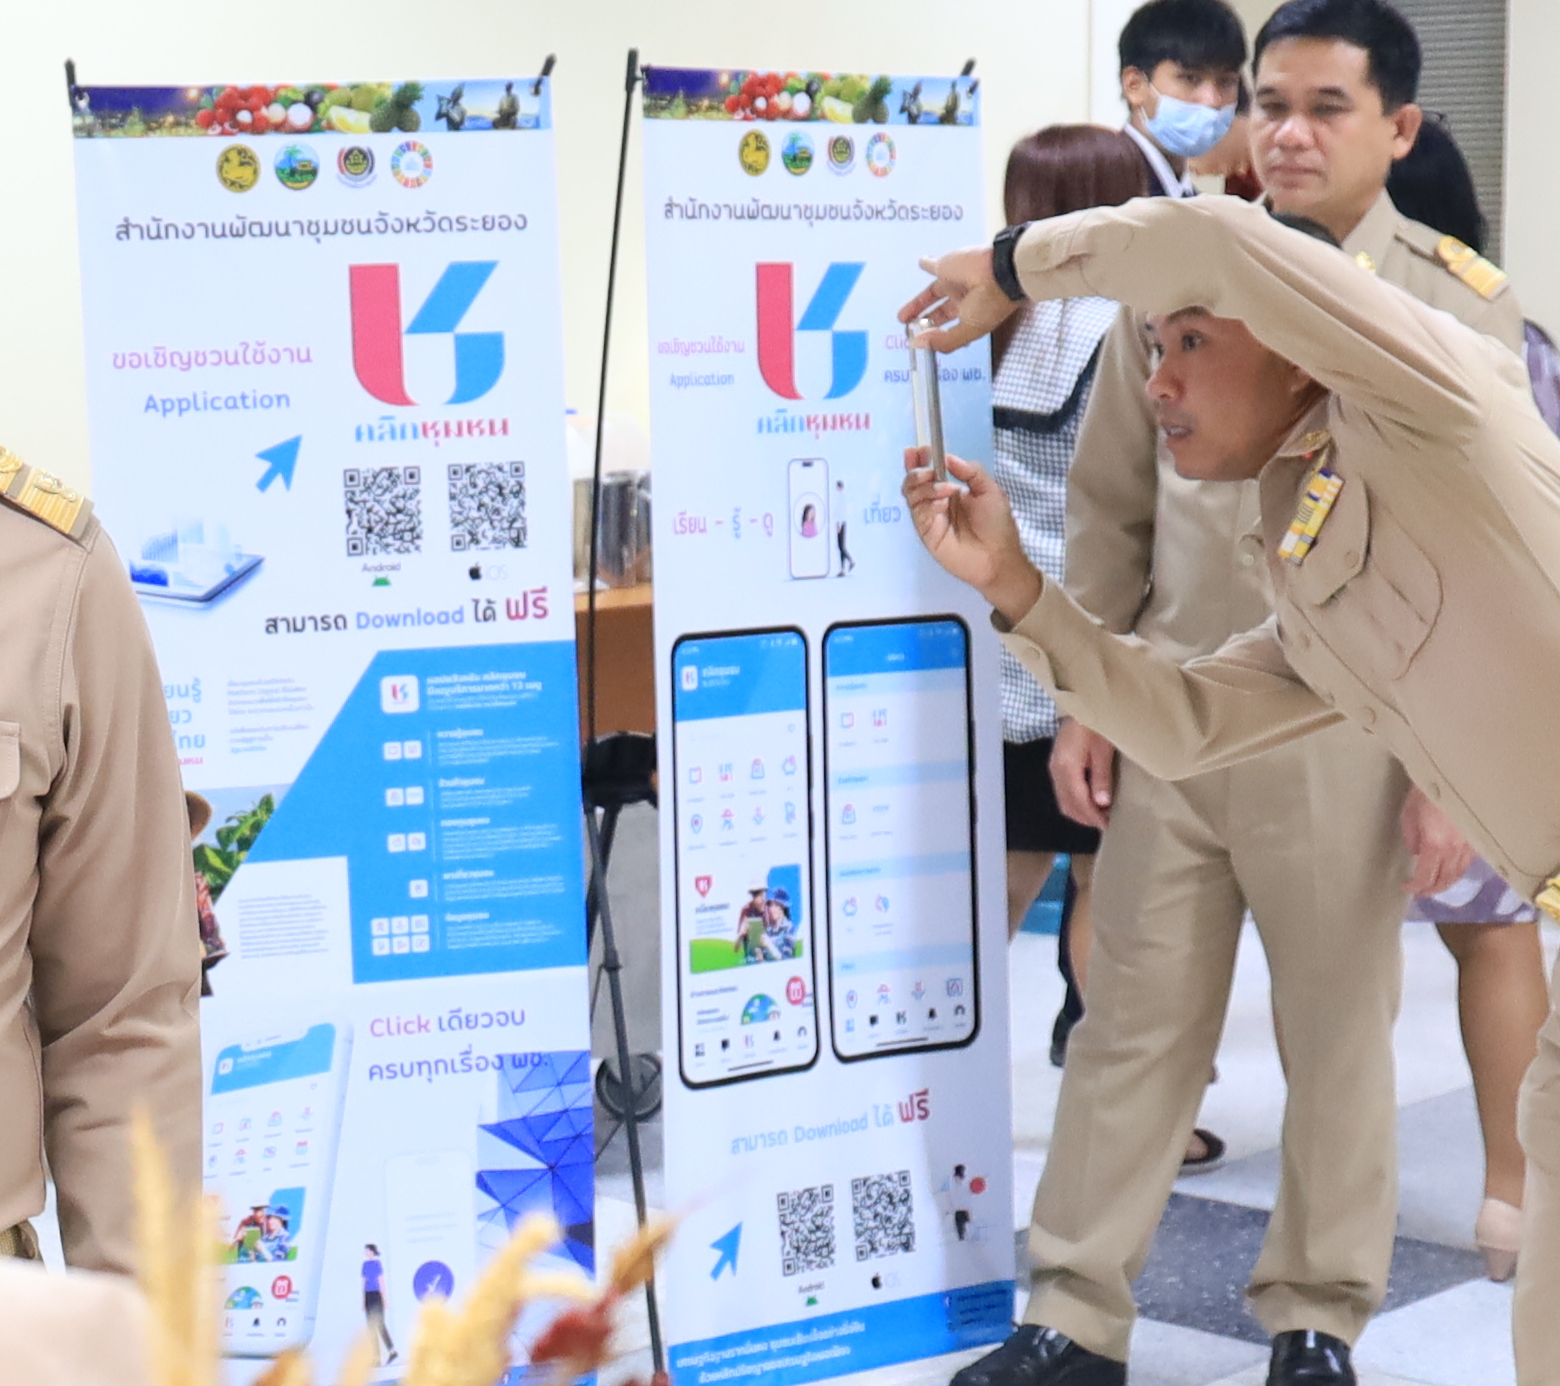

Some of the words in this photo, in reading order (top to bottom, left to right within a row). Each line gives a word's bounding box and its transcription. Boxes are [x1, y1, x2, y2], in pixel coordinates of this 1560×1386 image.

[115, 211, 527, 243] สำนักงานพัฒนาชุมชนจังหวัดระยอง
[664, 196, 963, 227] สำนักงานพัฒนาชุมชนจังหวัดระยอง
[112, 340, 313, 371] ขอเชิญชวนใช้งาน
[657, 336, 745, 357] ขอเชิญชวนใช้งาน
[670, 371, 735, 389] Application
[144, 389, 291, 417] Application
[361, 562, 401, 574] Android
[265, 613, 347, 634] สามารถ
[356, 606, 464, 629] Download
[472, 598, 497, 623] ได้
[506, 586, 549, 621] ฟรี
[370, 1014, 431, 1037] Click
[438, 1007, 526, 1031] เดียวจบ
[369, 1043, 504, 1084] ครบทุกเรื่อง
[731, 1129, 788, 1155] สามารถ
[794, 1113, 868, 1143] Download
[899, 1088, 931, 1123] ฟรี
